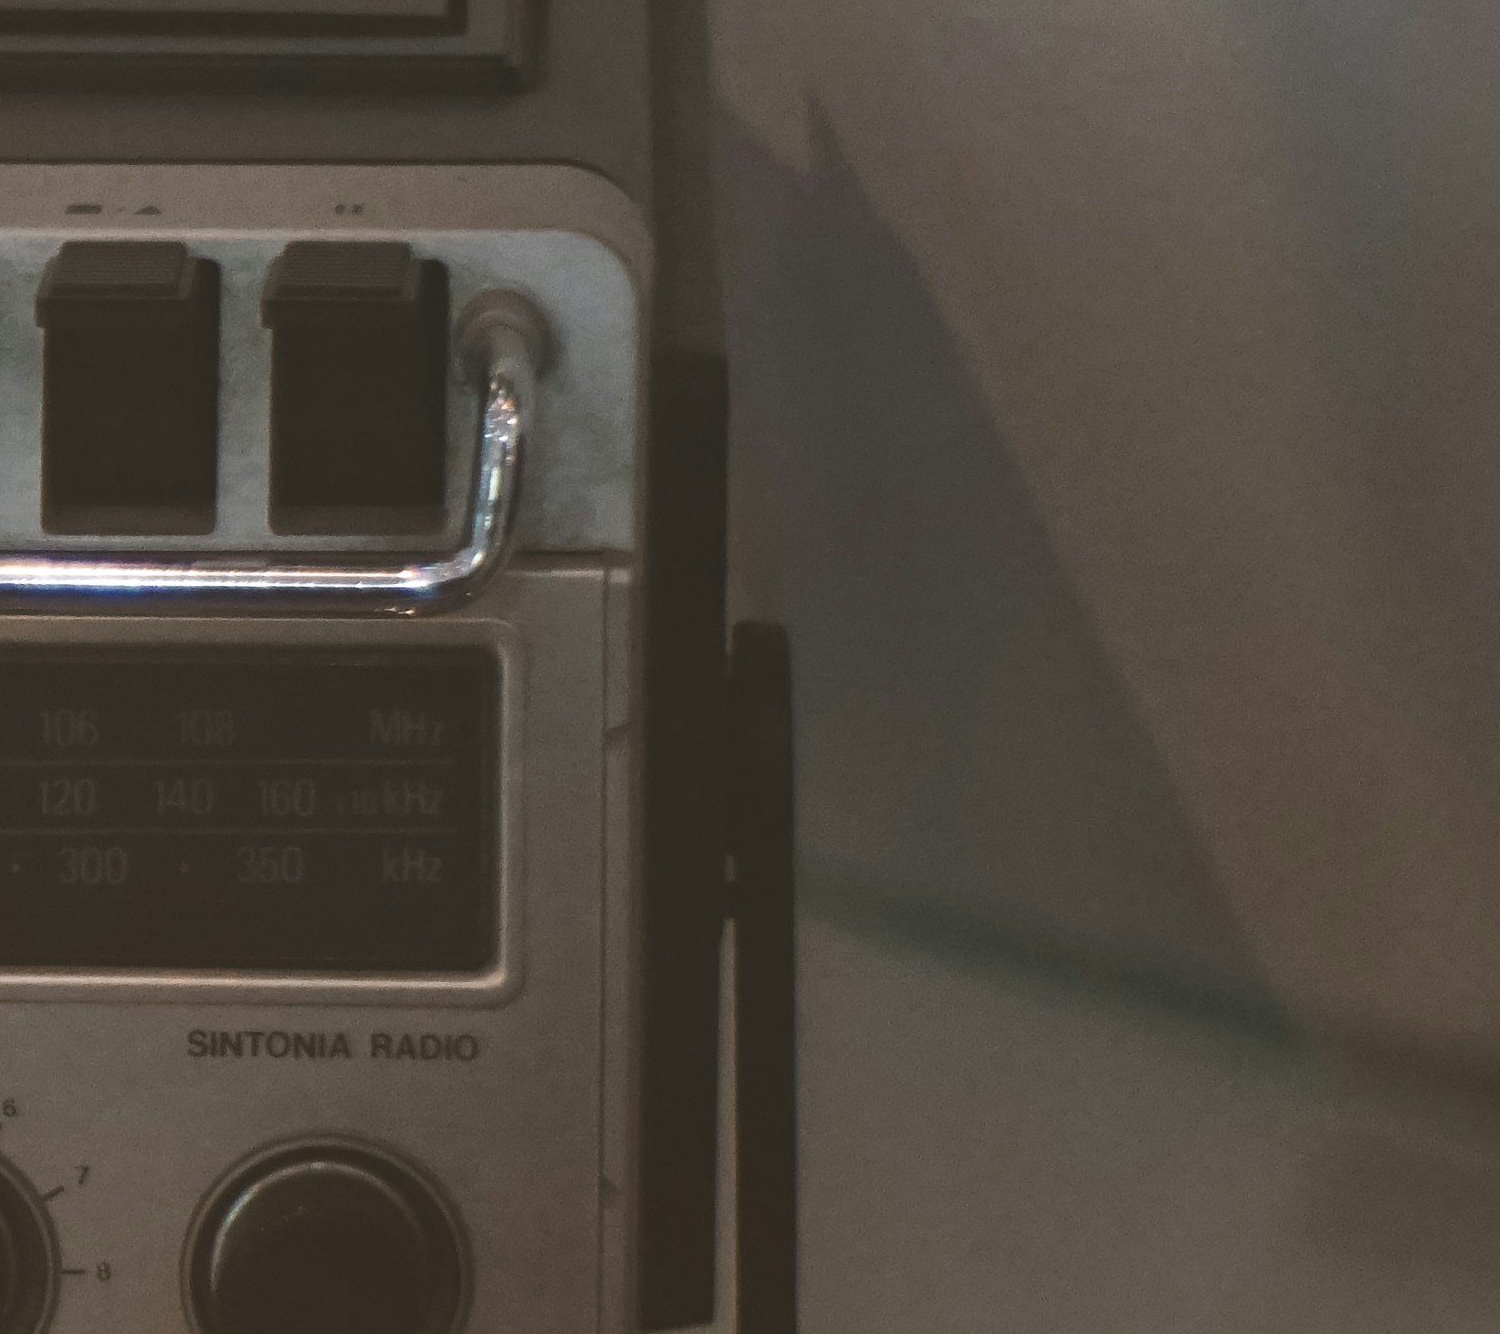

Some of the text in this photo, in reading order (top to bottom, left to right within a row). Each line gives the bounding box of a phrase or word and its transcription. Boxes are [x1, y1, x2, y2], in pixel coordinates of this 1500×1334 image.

[39, 708, 99, 747] 106
[179, 708, 236, 747] 108
[369, 708, 445, 747] MHz
[40, 778, 97, 817] 120
[155, 778, 215, 815] 140
[257, 778, 316, 817] 160
[383, 779, 444, 815] kHz
[58, 846, 128, 885] 300
[237, 845, 305, 884] 350
[382, 848, 443, 883] kHz
[188, 1030, 480, 1062] SINTONIA RADIO
[3, 1098, 17, 1118] 6
[77, 1166, 90, 1185] 7
